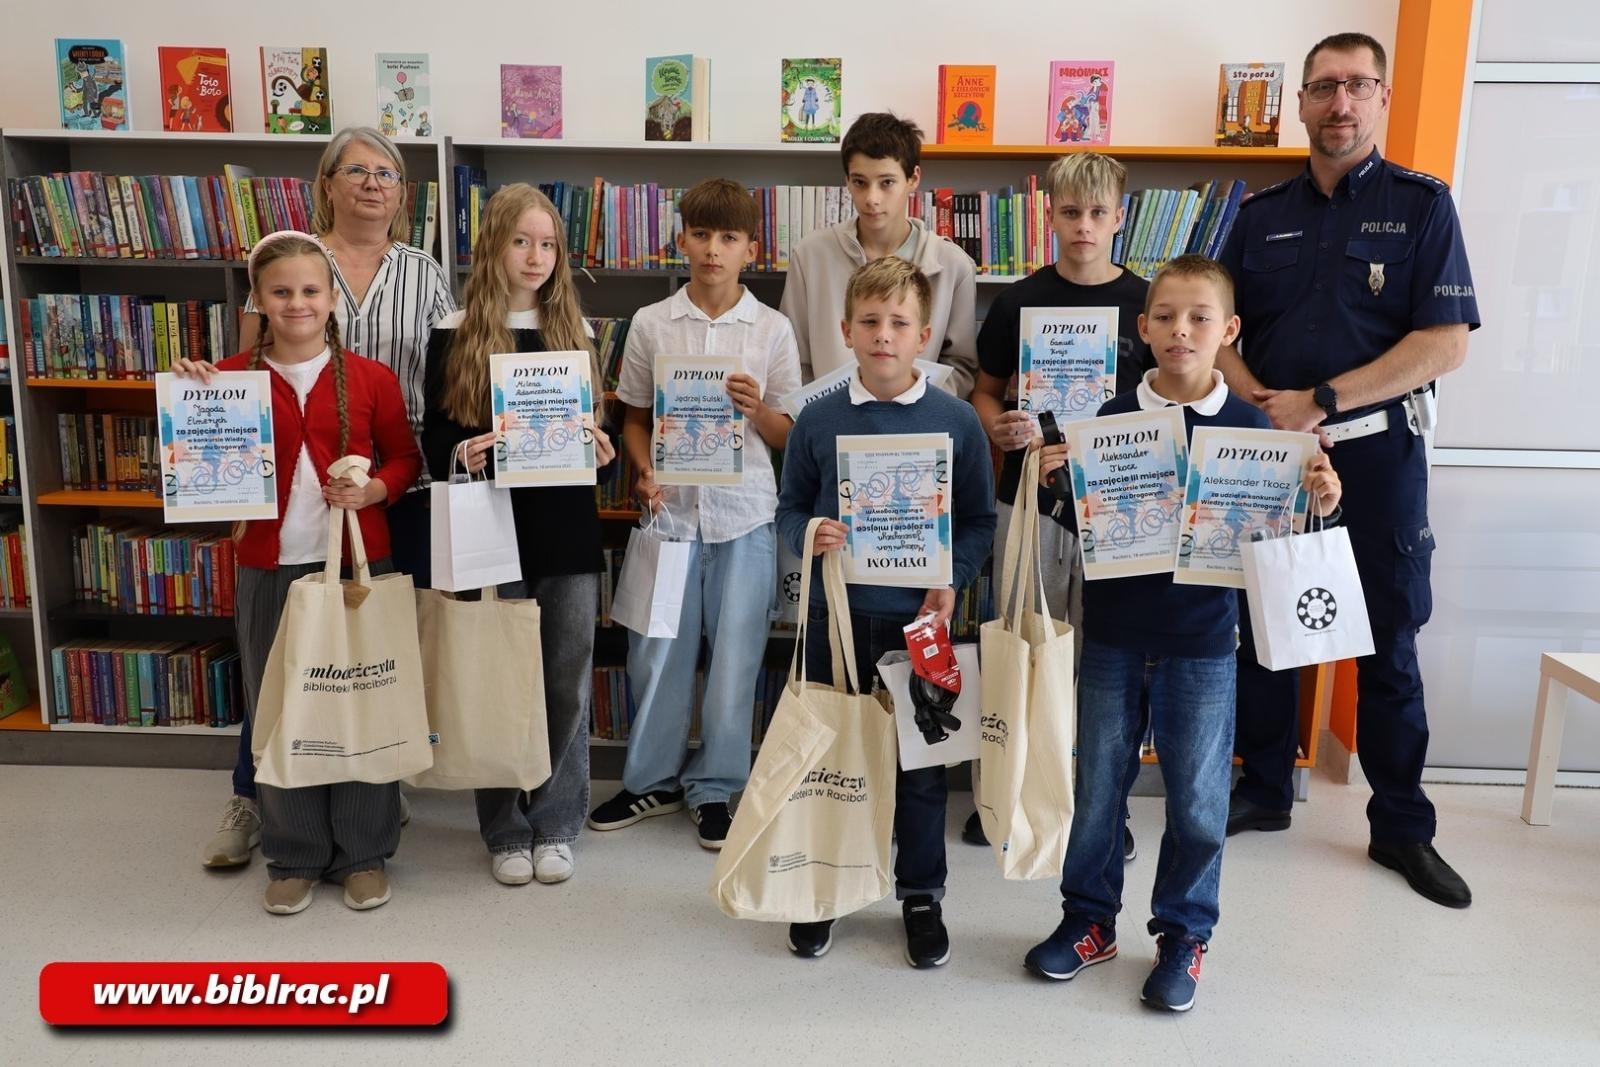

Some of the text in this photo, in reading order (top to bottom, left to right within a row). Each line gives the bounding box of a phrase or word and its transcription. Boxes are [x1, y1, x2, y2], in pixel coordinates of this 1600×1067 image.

[1060, 66, 1108, 77] MRÓWKI
[1250, 70, 1274, 79] porad
[957, 75, 984, 86] ANNE
[1359, 161, 1374, 178] POLICJA
[1361, 222, 1406, 234] POLICJA
[1434, 285, 1474, 297] POLICJA
[1042, 324, 1097, 334] DYPLOM
[513, 367, 568, 377] DYPLOM
[674, 370, 724, 380] DYPLOM
[184, 389, 246, 400] DYPLOM
[675, 395, 700, 403] Jędrzej
[517, 399, 543, 407] zajęcie
[193, 404, 226, 416] Jagoda
[188, 427, 217, 436] zajęcie
[225, 427, 257, 435] miejsca
[1093, 429, 1159, 449] DYPLOM
[1100, 449, 1149, 463] Aleksander
[1217, 447, 1287, 463] DYPLOM
[1099, 474, 1129, 486] zajęcie
[1140, 470, 1175, 481] miejsca
[1204, 476, 1290, 490] Aleksander Tkocz
[1107, 485, 1138, 493] konkursie
[1130, 491, 1164, 500] Drogowym
[857, 525, 889, 533] miejsca
[894, 524, 923, 532] zajęcie
[868, 557, 926, 568] DYPLOM
[303, 682, 350, 694] Biblioteki
[815, 788, 824, 796] w
[1074, 934, 1098, 962] N
